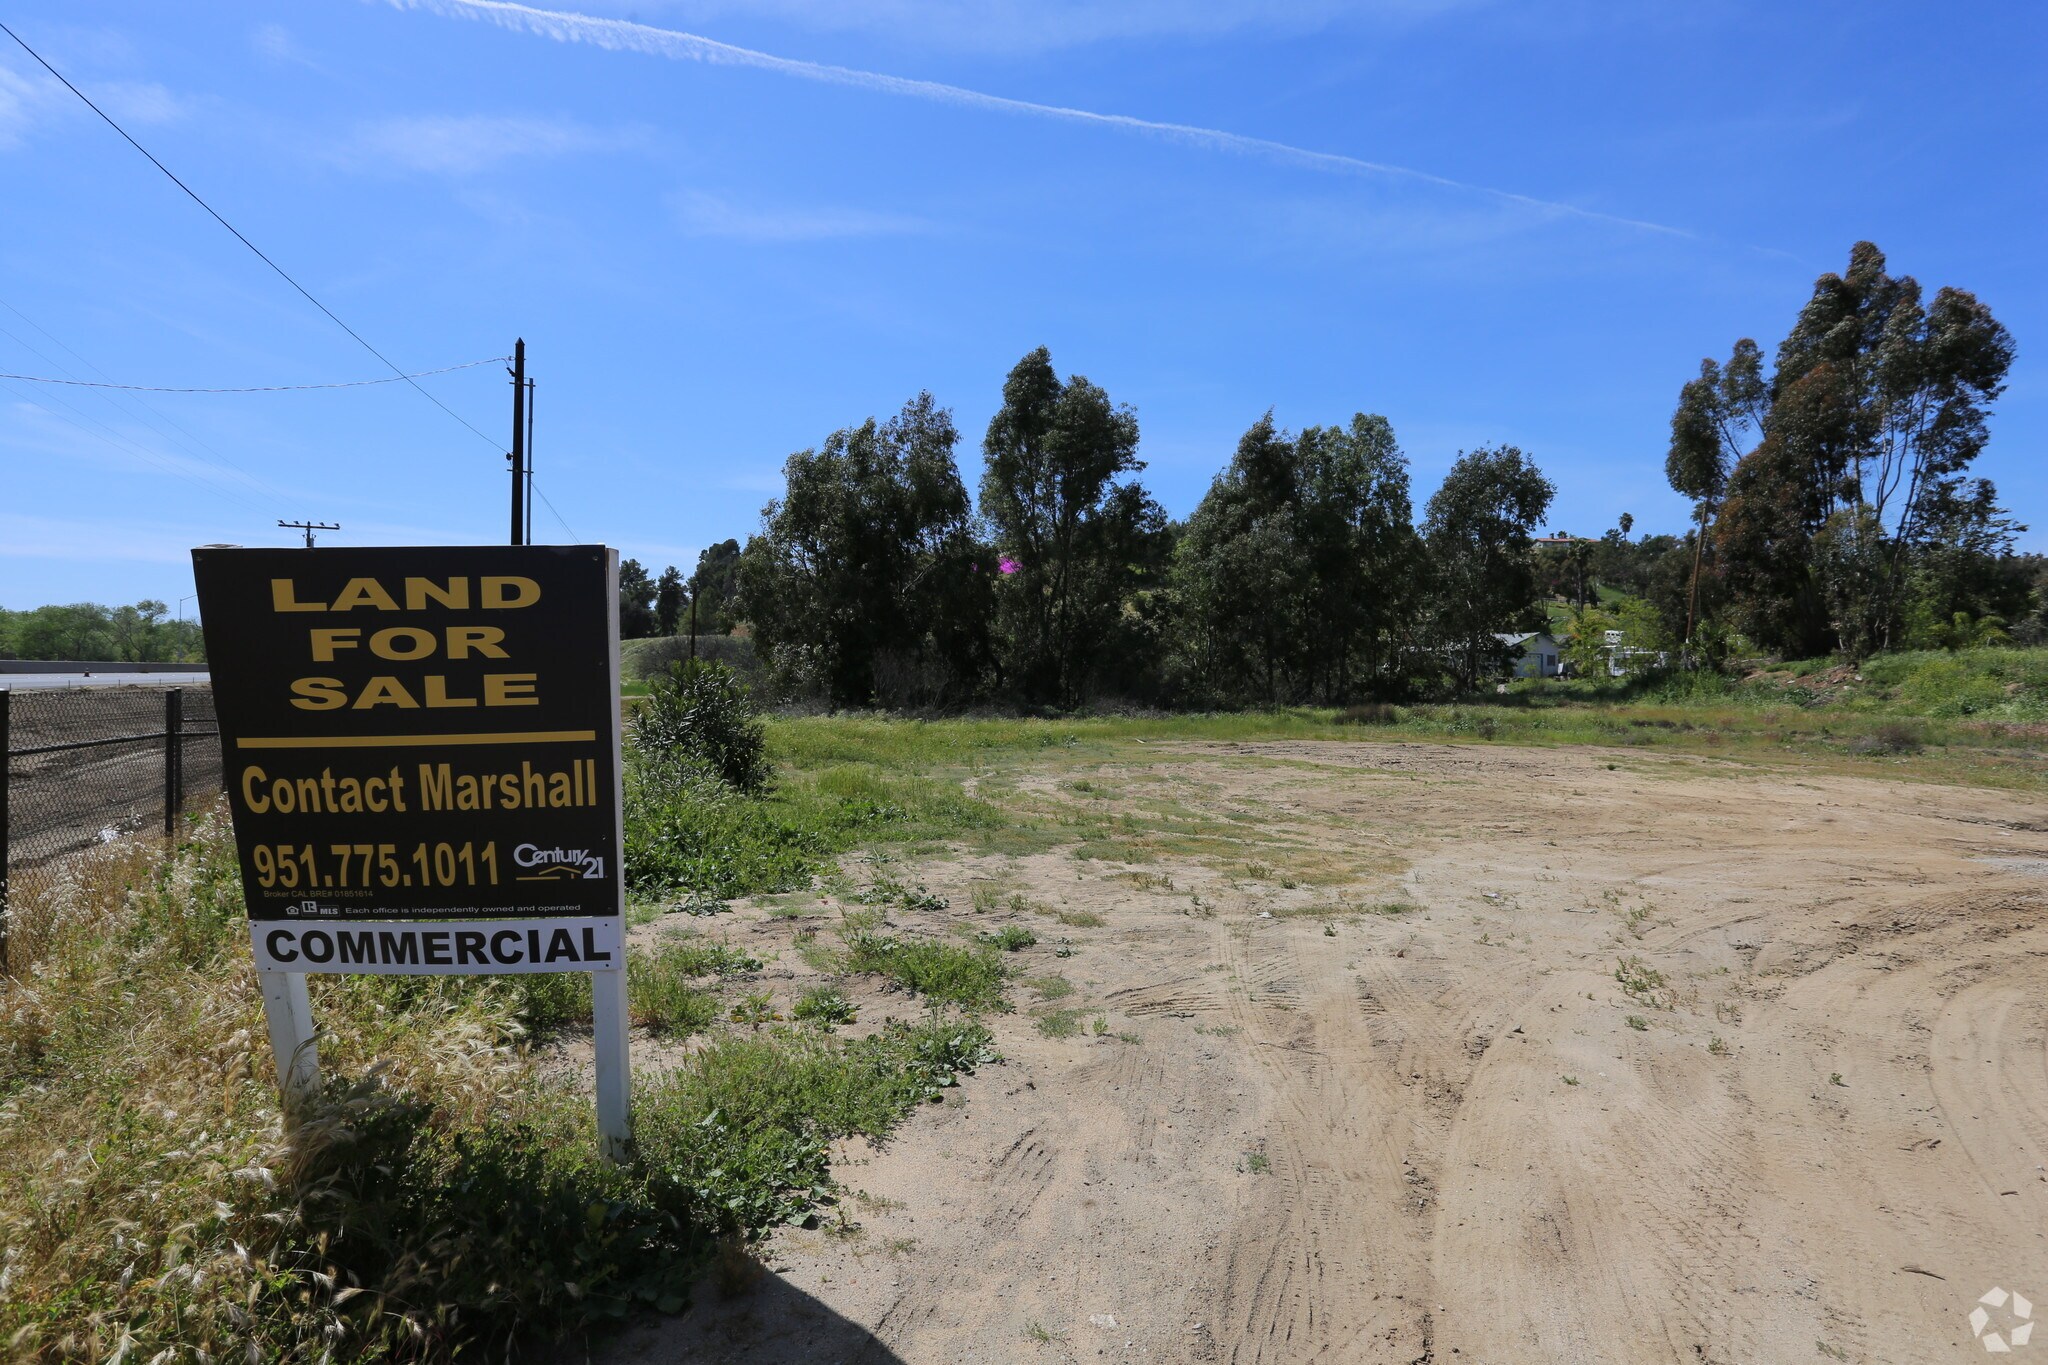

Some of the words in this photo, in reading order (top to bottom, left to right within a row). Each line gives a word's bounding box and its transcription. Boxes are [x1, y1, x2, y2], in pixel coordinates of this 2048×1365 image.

[270, 575, 542, 613] LAND
[309, 625, 511, 662] FOR
[289, 673, 540, 711] SALE
[241, 765, 407, 814] Contact
[418, 758, 597, 812] Marshall
[253, 840, 499, 888] 951.775.1011
[513, 842, 590, 868] Century
[582, 857, 605, 879] 21
[263, 890, 289, 898] Broker
[291, 890, 309, 898] CAL
[319, 907, 339, 915] MLS
[372, 906, 399, 914] office
[401, 906, 409, 914] is
[411, 904, 480, 915] independently
[482, 904, 515, 913] owned
[517, 904, 535, 912] and
[537, 904, 581, 913] operated
[265, 927, 611, 965] COMMERCIAL
